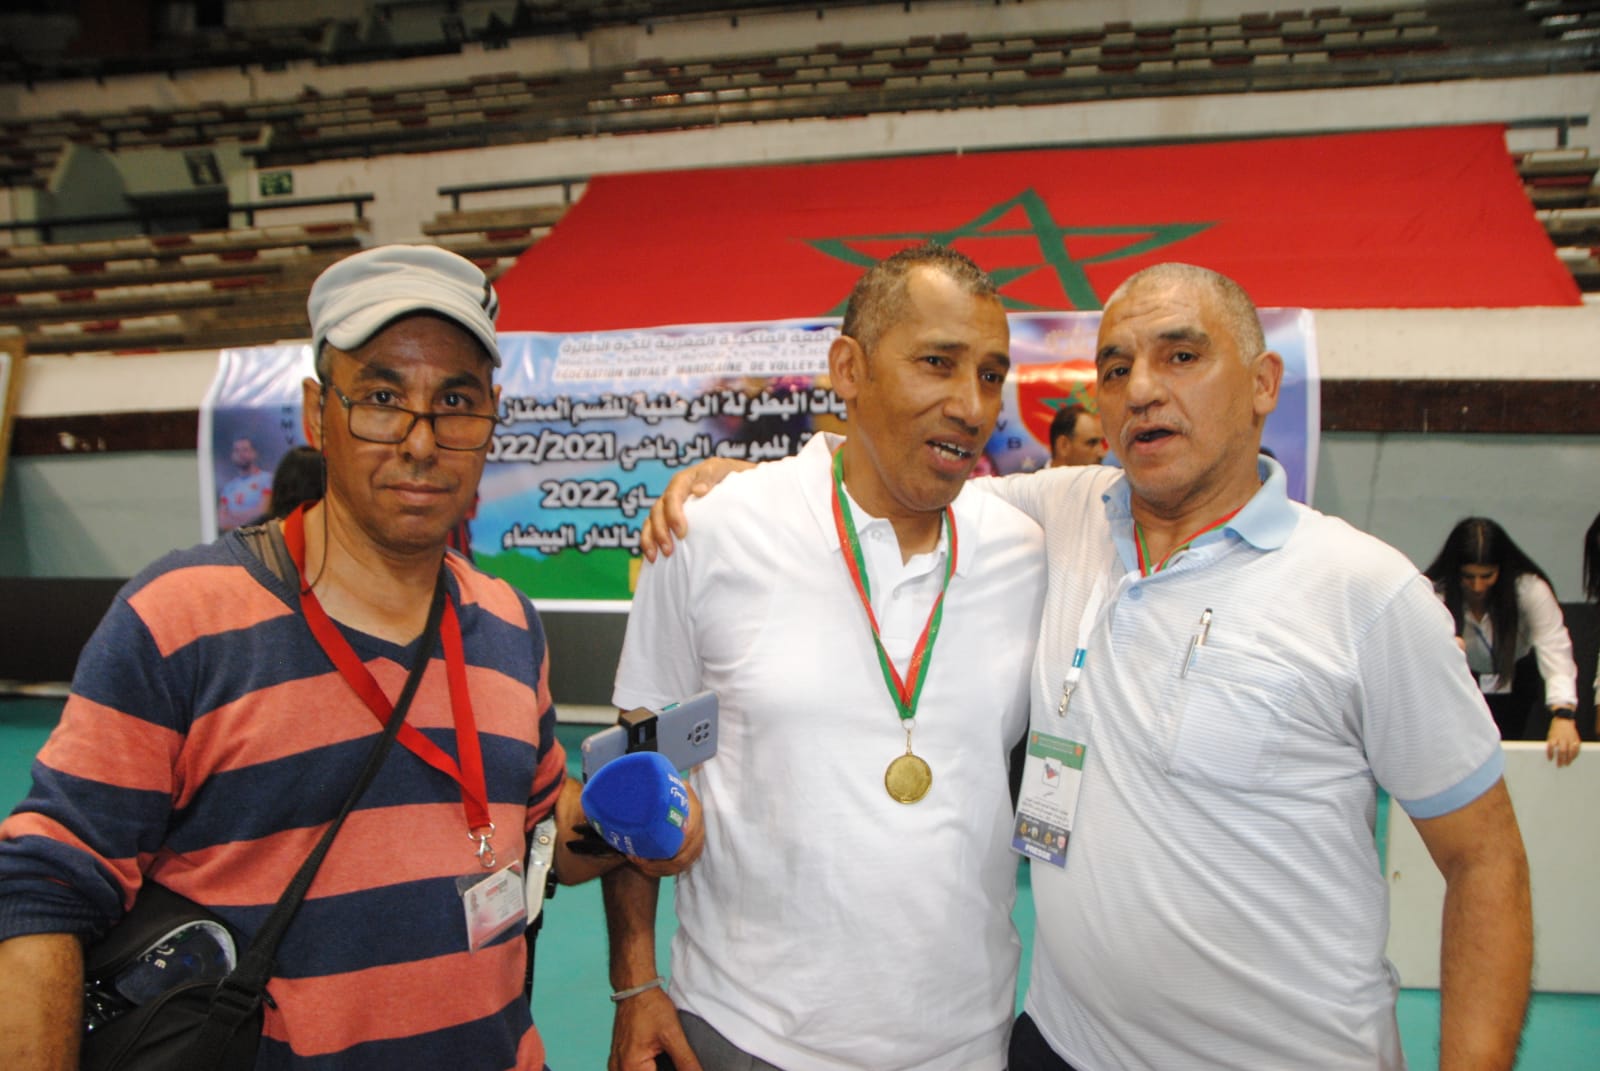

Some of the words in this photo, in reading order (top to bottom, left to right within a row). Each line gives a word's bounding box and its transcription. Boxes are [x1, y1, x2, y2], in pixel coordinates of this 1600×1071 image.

[750, 360, 765, 371] DE
[502, 394, 571, 426] الممتاز
[572, 392, 630, 427] للقسم
[633, 391, 718, 424] الوطنية
[722, 389, 808, 422] البطولة
[620, 433, 710, 471] الرياضي
[541, 479, 618, 508] 2022
[502, 522, 577, 554] البيضاء
[579, 522, 643, 556] بالدار
